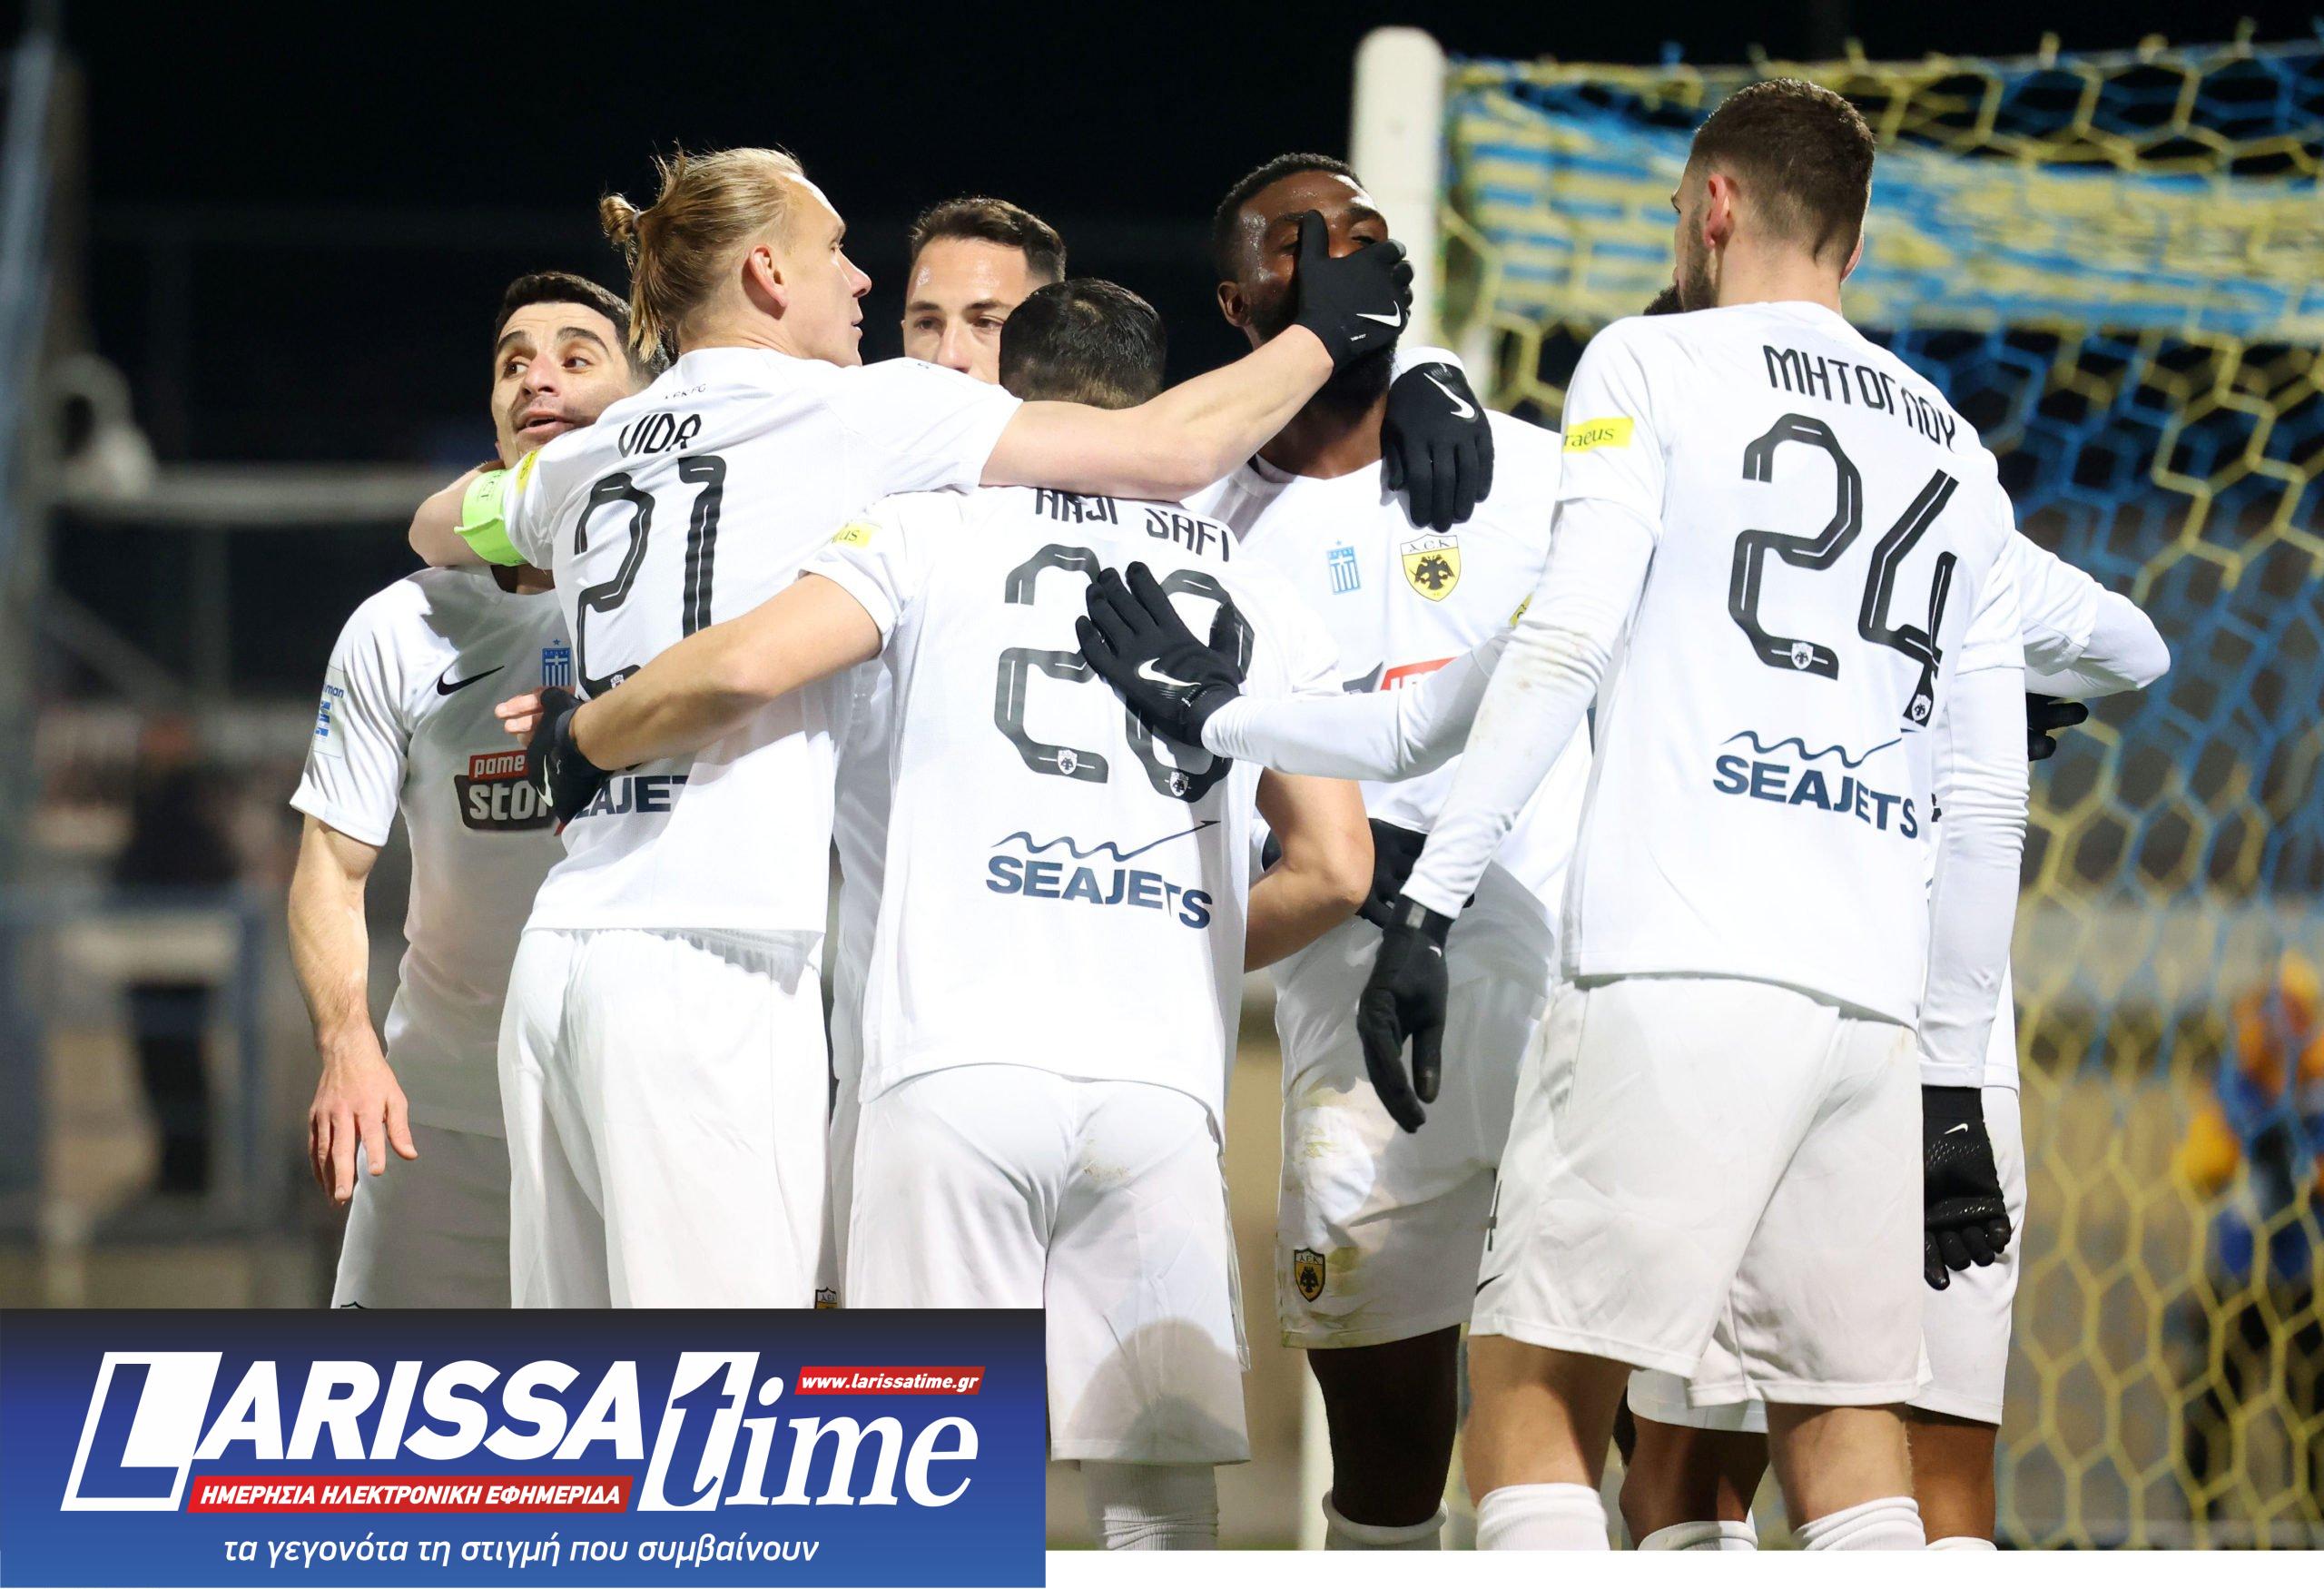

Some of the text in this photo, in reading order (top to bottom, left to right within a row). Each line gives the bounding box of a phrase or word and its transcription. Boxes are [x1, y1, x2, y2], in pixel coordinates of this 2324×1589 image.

[618, 413, 702, 458] VIDA
[1144, 508, 1229, 562] SAFI
[1728, 413, 1959, 727] 24
[575, 455, 726, 698] 21
[474, 755, 526, 778] pame
[1712, 755, 1918, 839] SEAJETS
[986, 855, 1214, 930] SEAJETS
